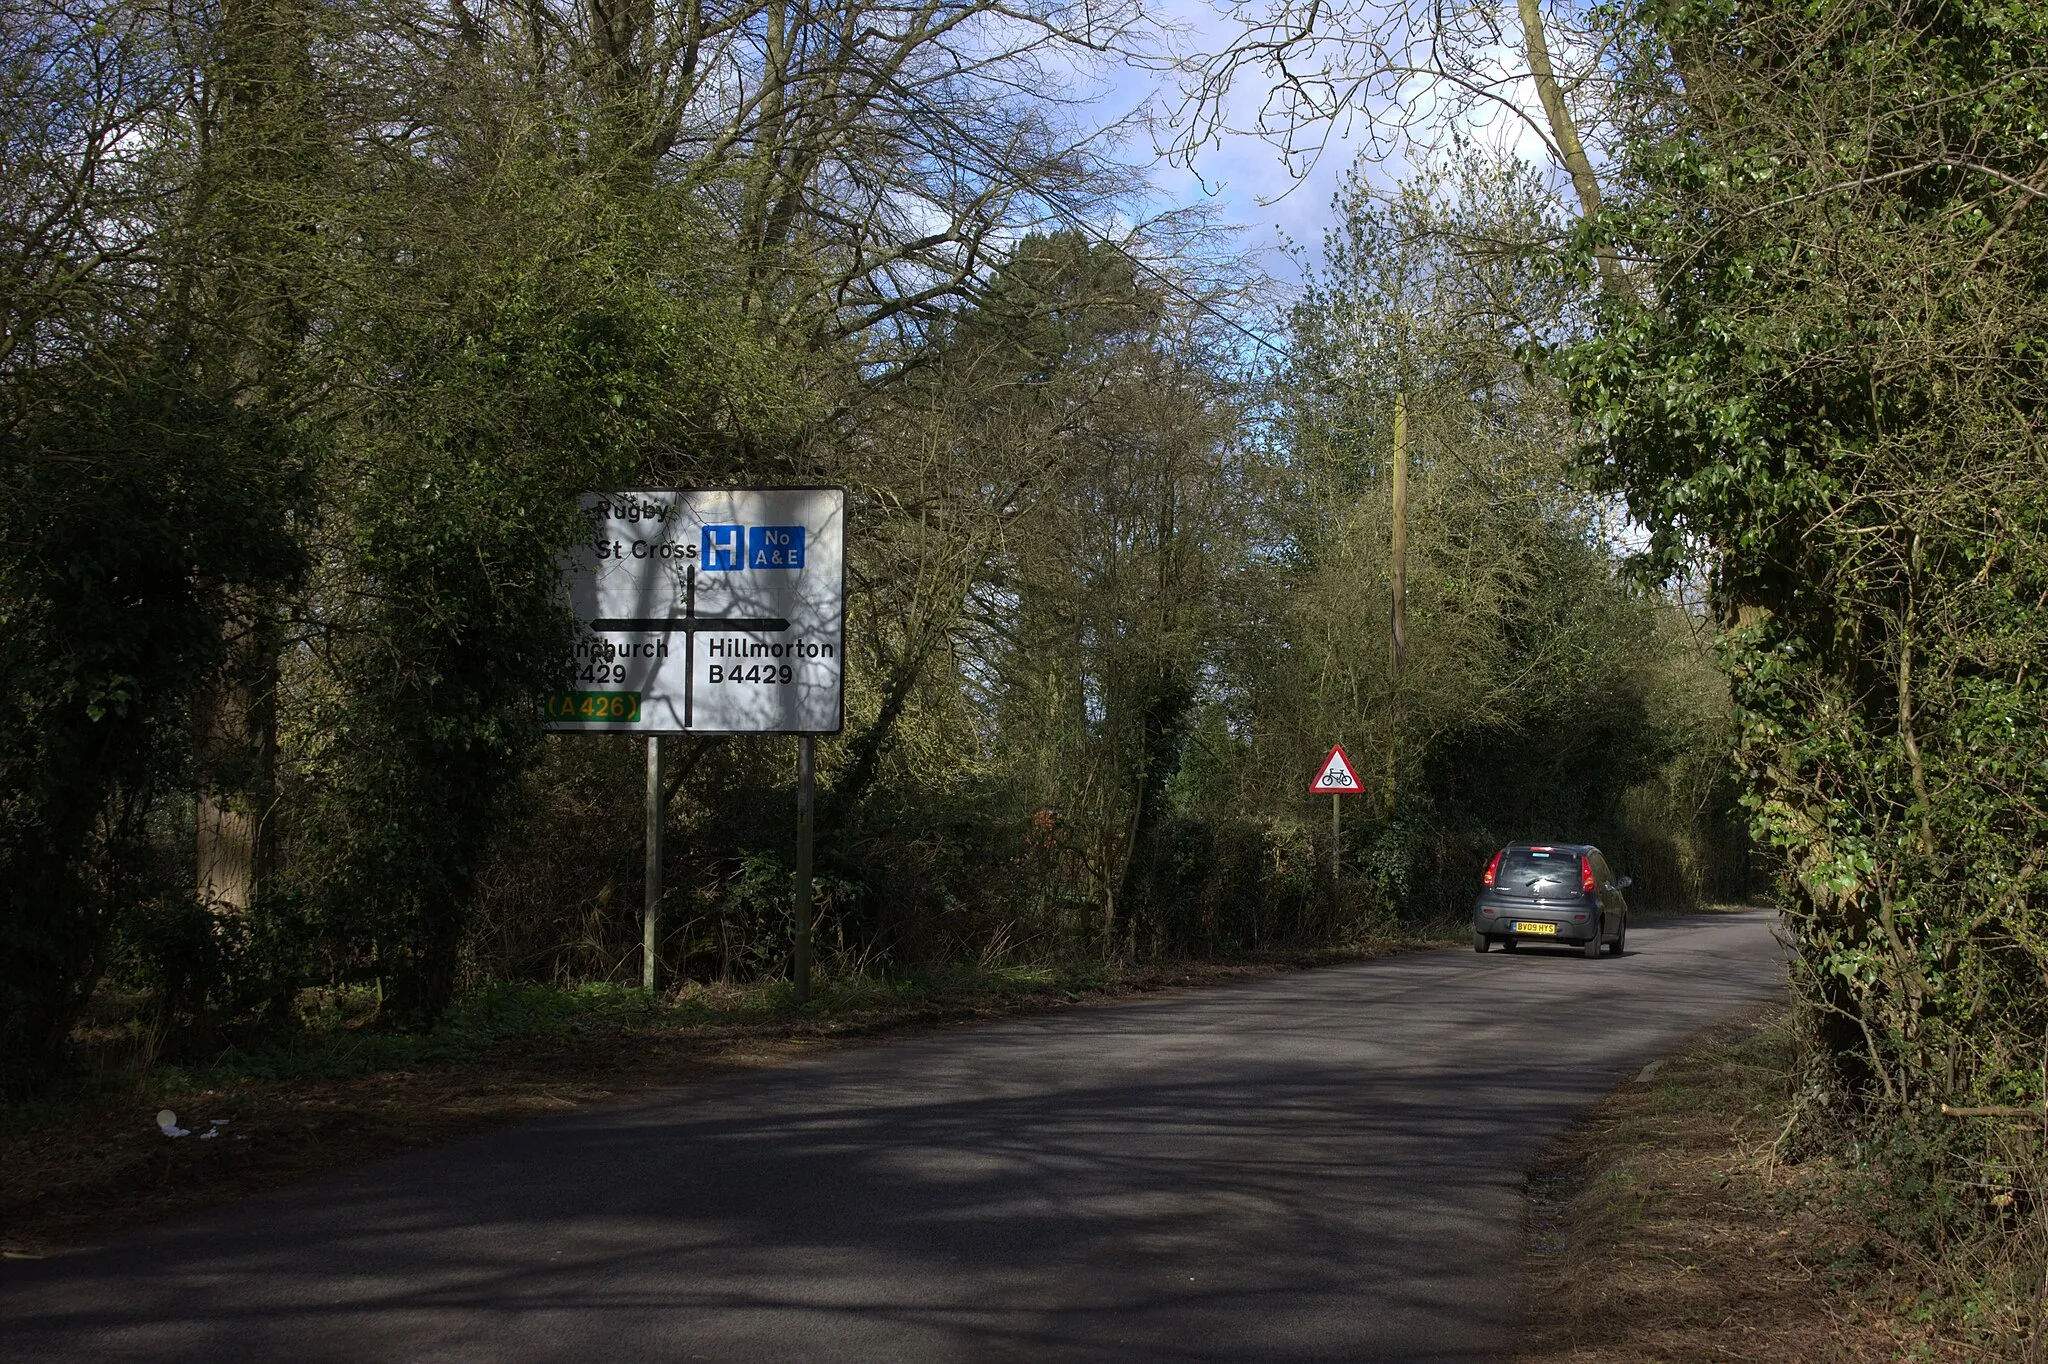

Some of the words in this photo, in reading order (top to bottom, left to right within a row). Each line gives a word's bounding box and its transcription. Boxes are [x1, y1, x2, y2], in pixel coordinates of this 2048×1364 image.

[597, 500, 668, 523] Rugby
[765, 530, 790, 545] No
[596, 540, 622, 559] St
[631, 540, 697, 559] Cross
[709, 530, 737, 566] H
[572, 638, 668, 658] nchurch
[709, 638, 834, 658] Hillmorton
[573, 664, 626, 684] 429
[1538, 924, 1554, 932] HYS
